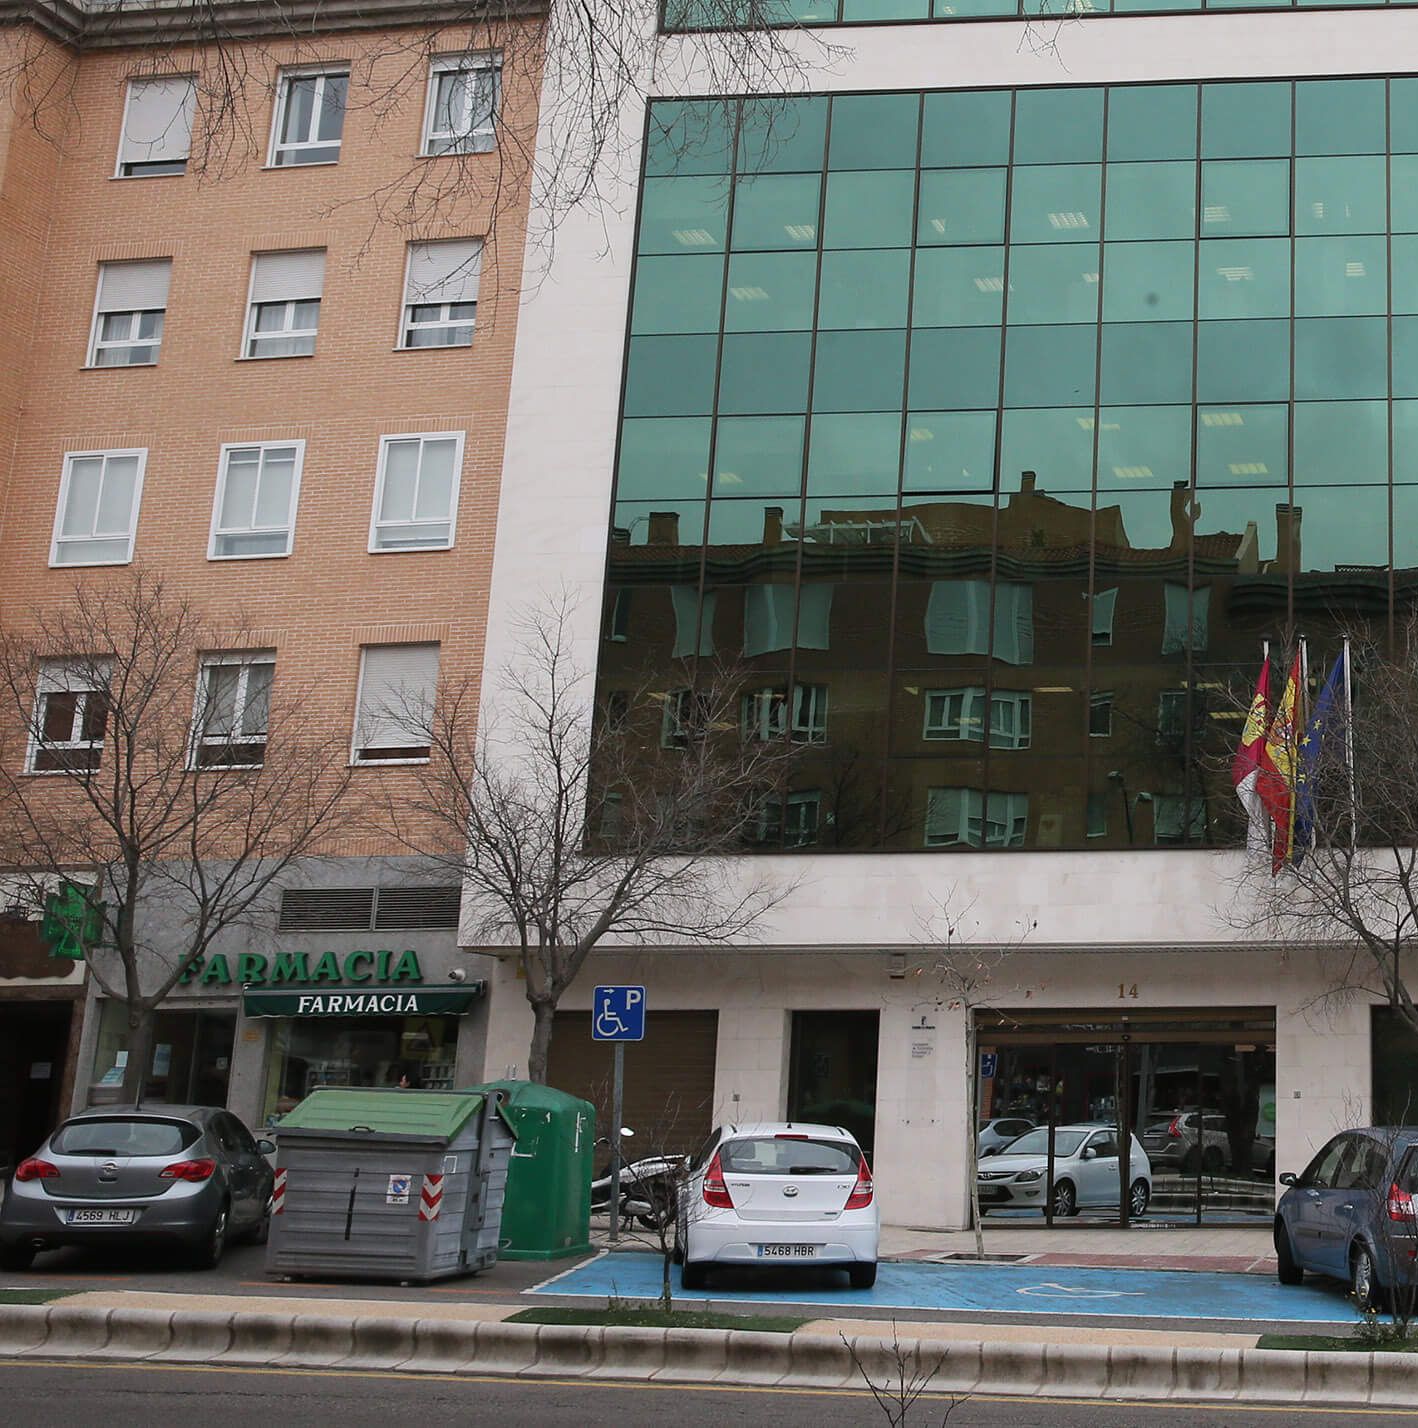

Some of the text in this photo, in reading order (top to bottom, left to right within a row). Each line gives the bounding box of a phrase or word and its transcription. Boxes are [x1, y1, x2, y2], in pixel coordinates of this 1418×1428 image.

[178, 950, 424, 985] FARMACIA
[625, 989, 642, 1010] P
[1118, 983, 1139, 999] 14
[297, 994, 419, 1014] FARMACIA
[76, 1210, 130, 1221] 4569 HLJ
[764, 1246, 815, 1257] 5468 HBR
